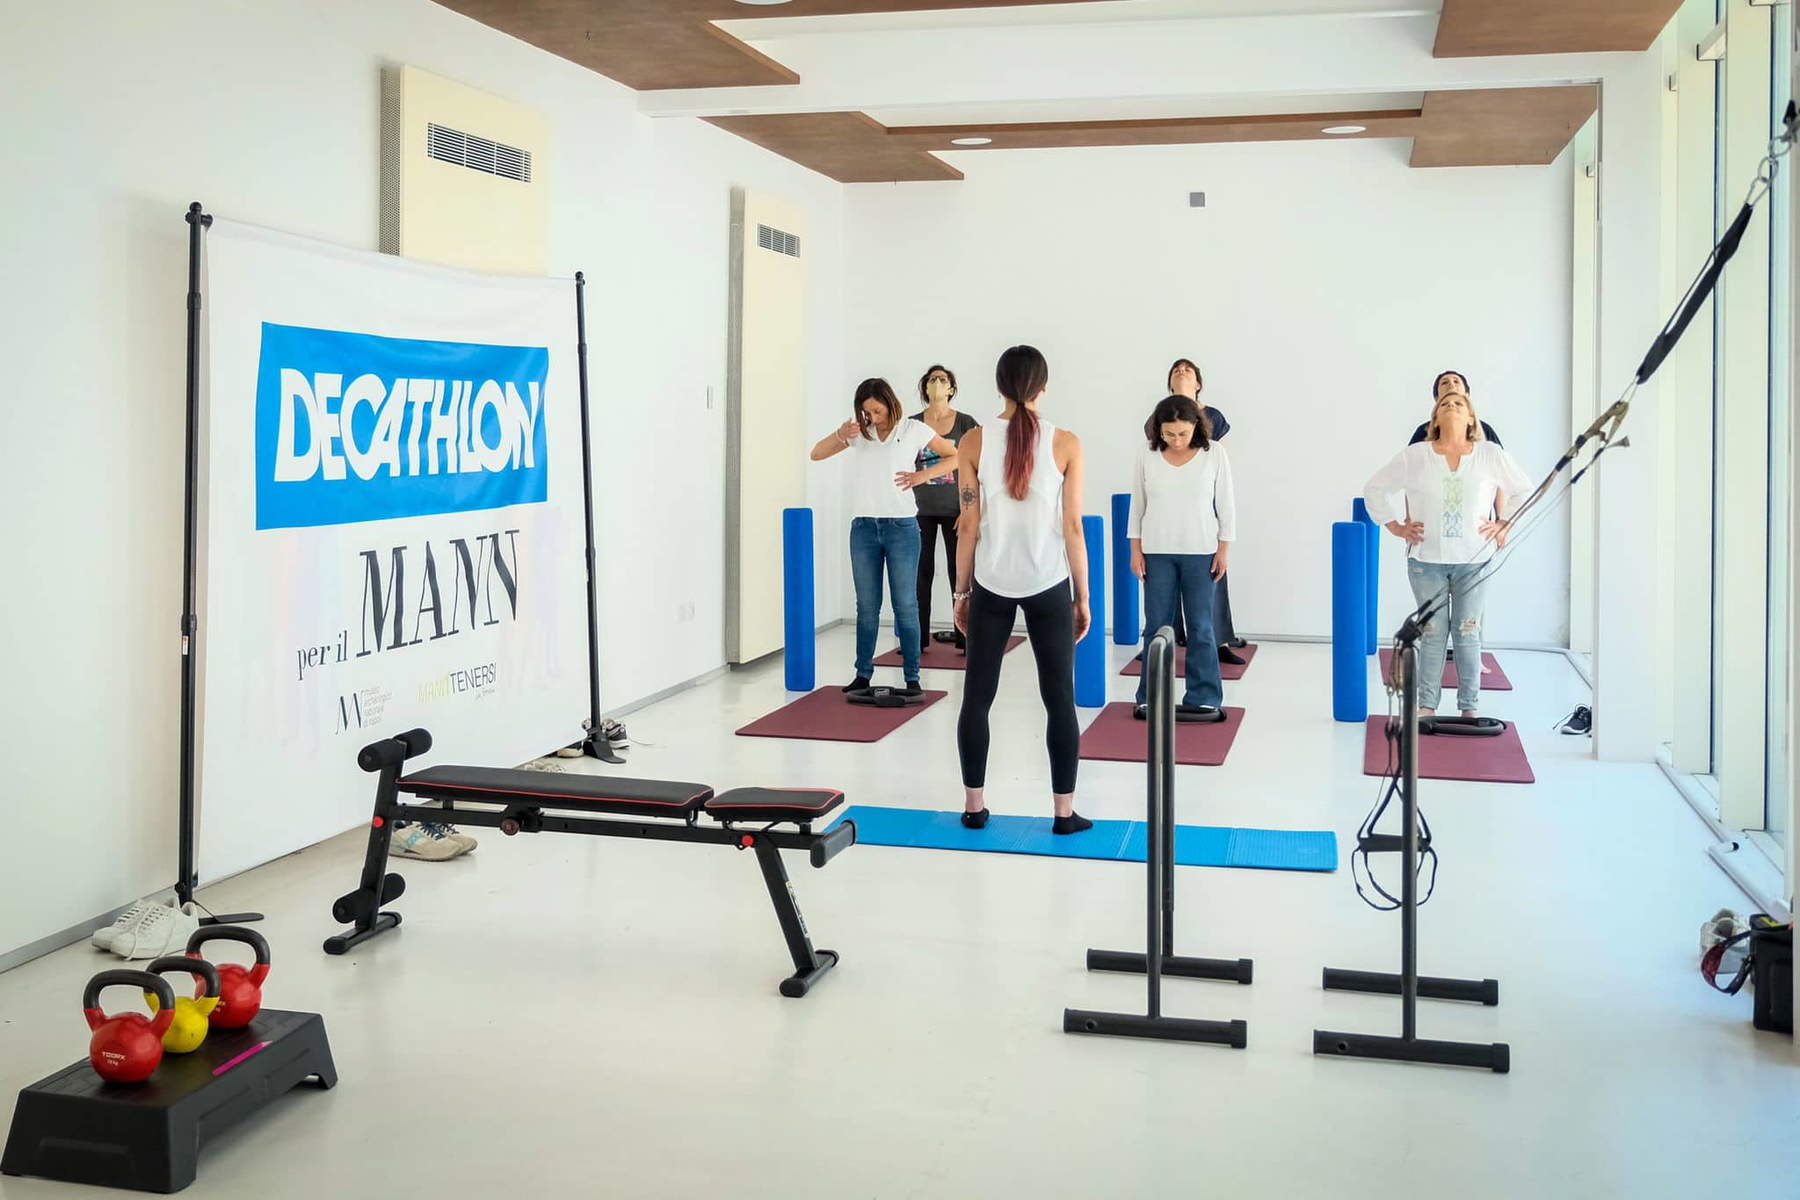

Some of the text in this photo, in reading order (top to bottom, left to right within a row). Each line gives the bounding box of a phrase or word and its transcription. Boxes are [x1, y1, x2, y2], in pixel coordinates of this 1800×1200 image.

[273, 367, 540, 483] DECATHLON
[296, 529, 520, 680] per il MANN
